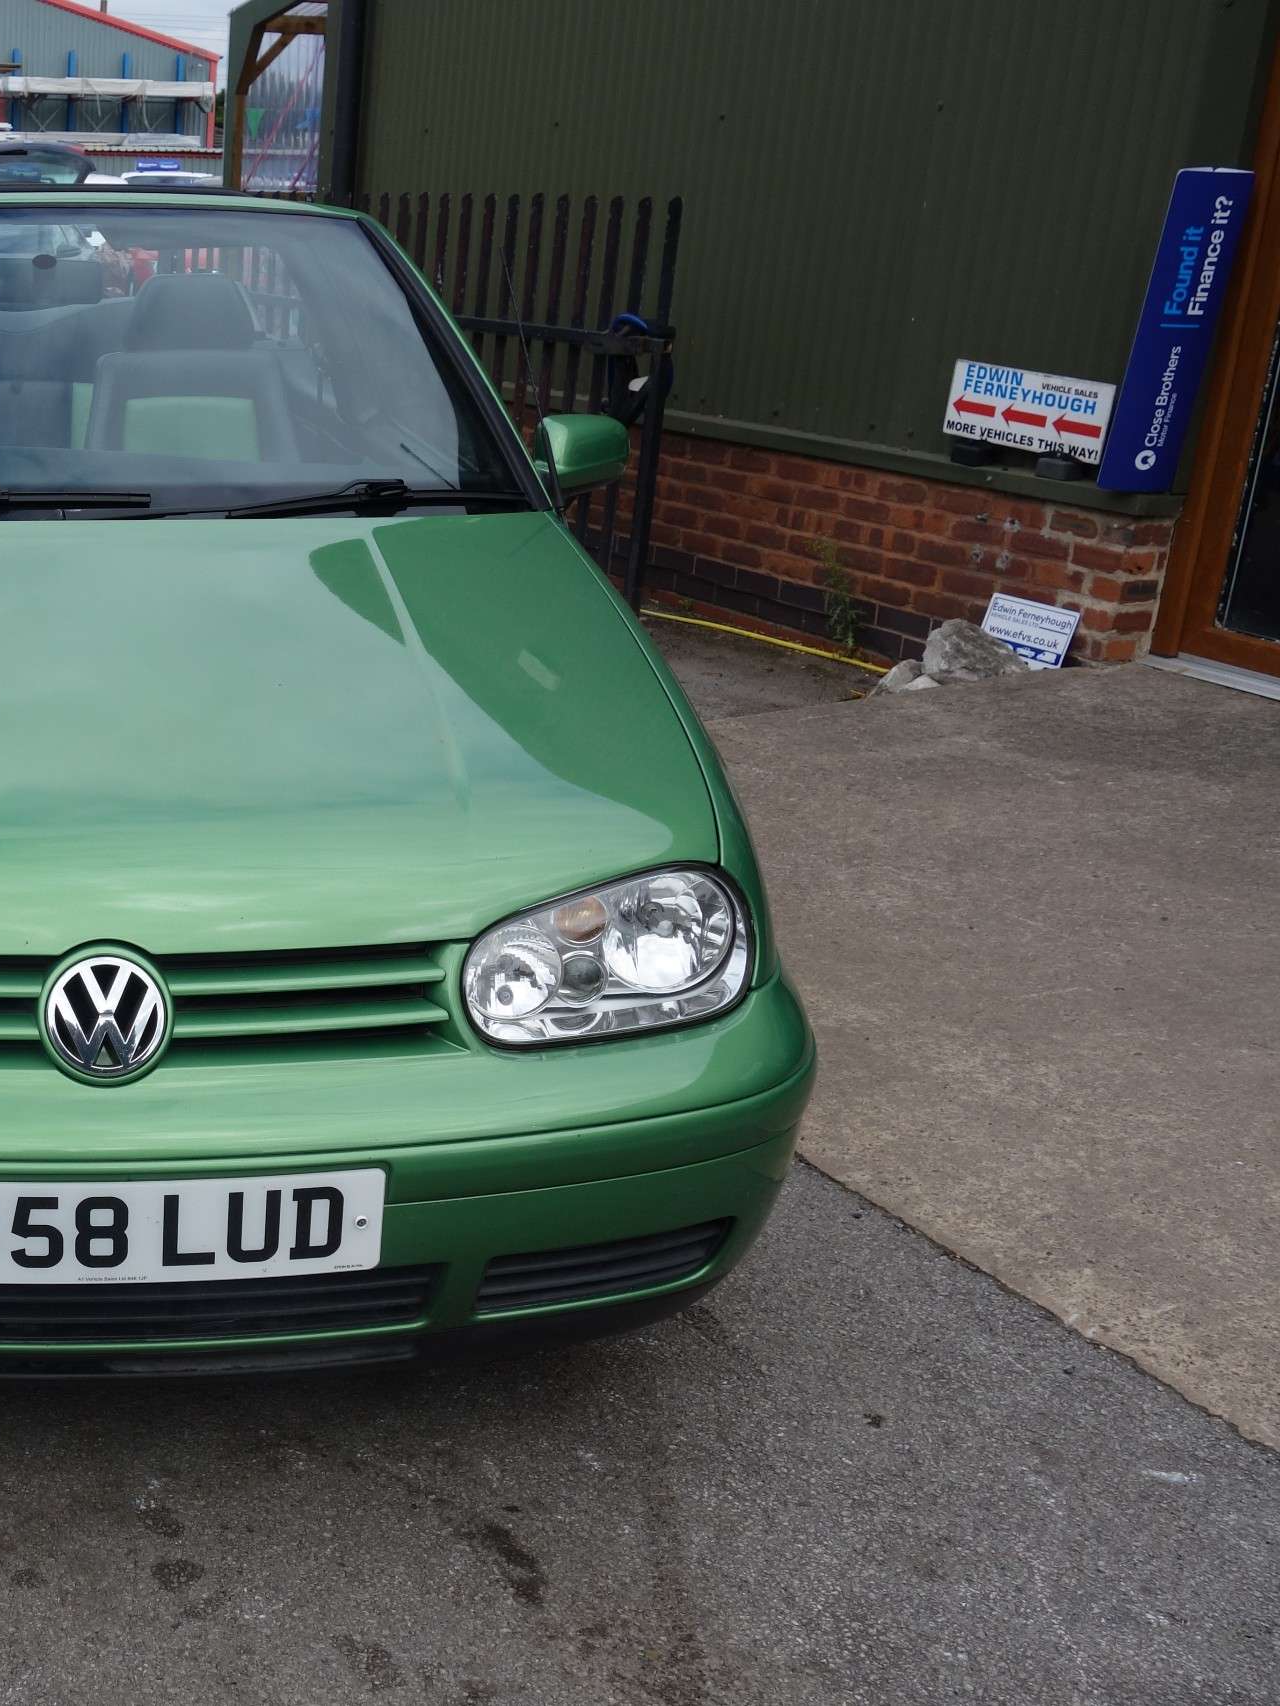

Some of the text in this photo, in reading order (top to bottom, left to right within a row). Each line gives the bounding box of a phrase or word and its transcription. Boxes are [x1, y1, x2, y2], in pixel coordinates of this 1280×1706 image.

[1164, 226, 1204, 315] Found it
[1187, 195, 1233, 316] Finance it?
[966, 364, 1024, 387] EDWIN
[1041, 382, 1099, 399] VEHICLE SALES
[963, 378, 1097, 416] FERNEYHOUGH
[1144, 345, 1182, 447] Close Brothers
[946, 419, 1099, 461] MORE VEHICLES THIS WAY!
[992, 602, 1073, 630] Edwin Ferneyhough
[989, 625, 1060, 650] www.efvs.co.uk
[162, 1186, 344, 1267] LUD
